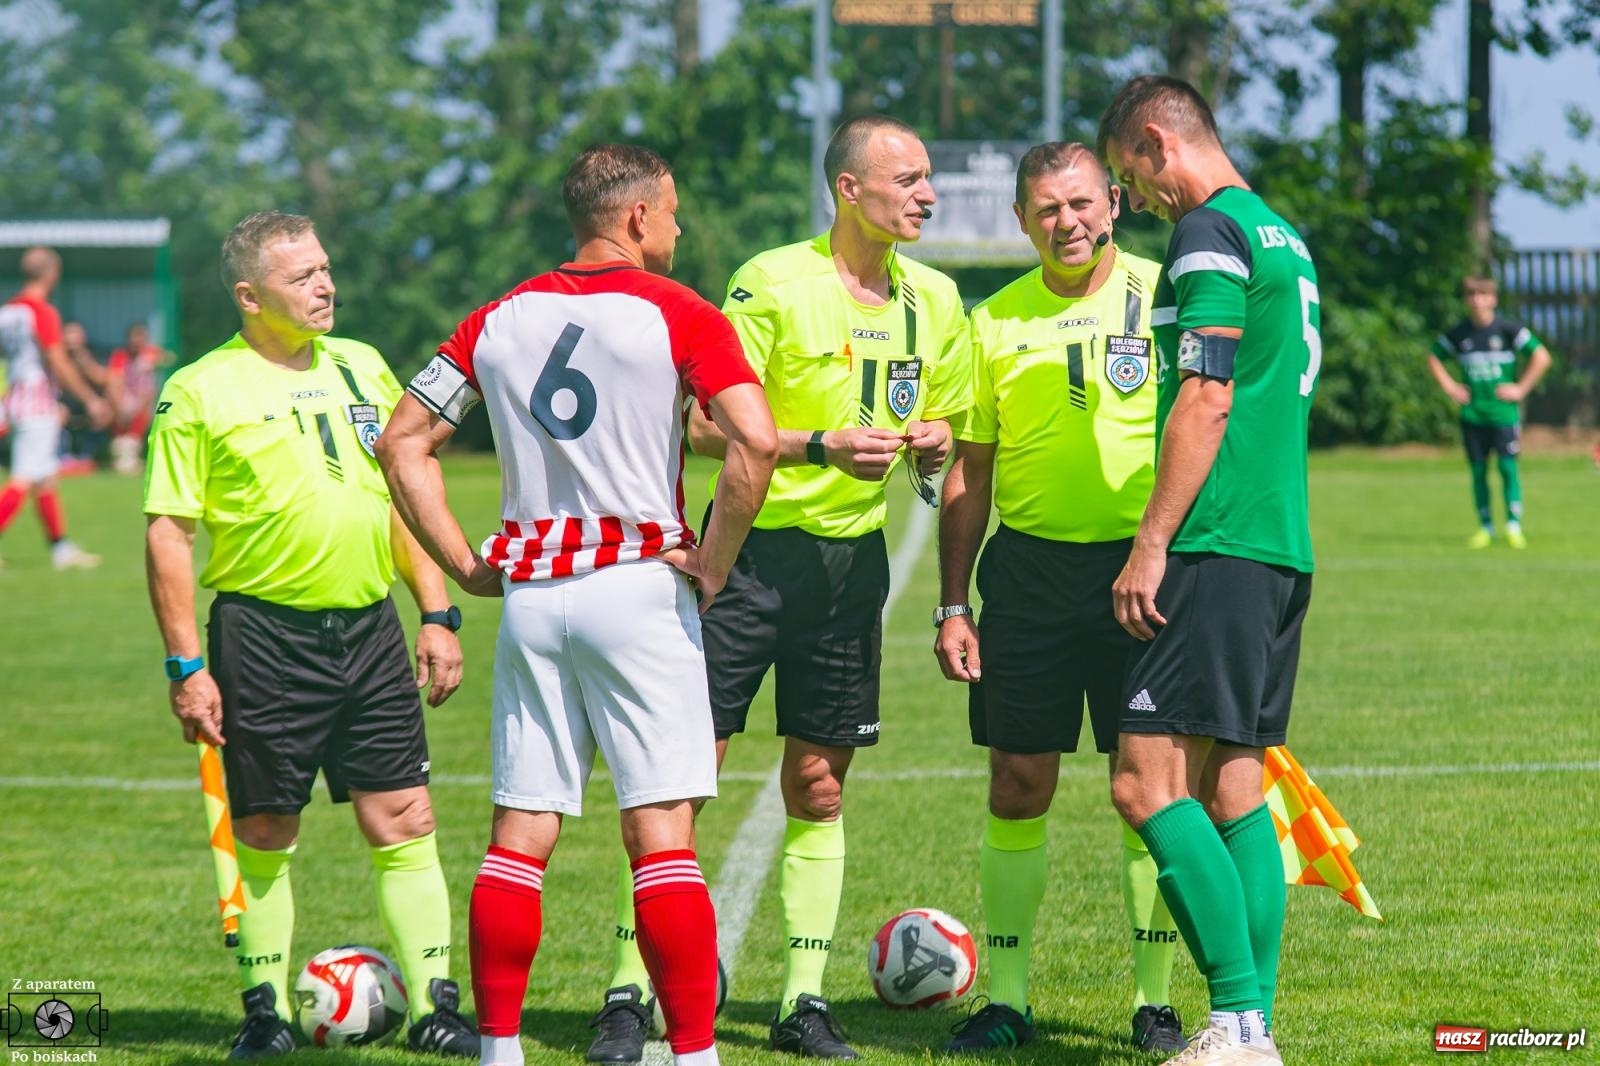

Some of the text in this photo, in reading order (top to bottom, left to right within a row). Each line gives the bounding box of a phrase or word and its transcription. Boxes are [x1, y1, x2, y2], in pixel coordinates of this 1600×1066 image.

[1297, 275, 1322, 397] 5
[529, 321, 598, 441] 6
[1128, 702, 1157, 712] adidas
[986, 933, 1019, 948] ina
